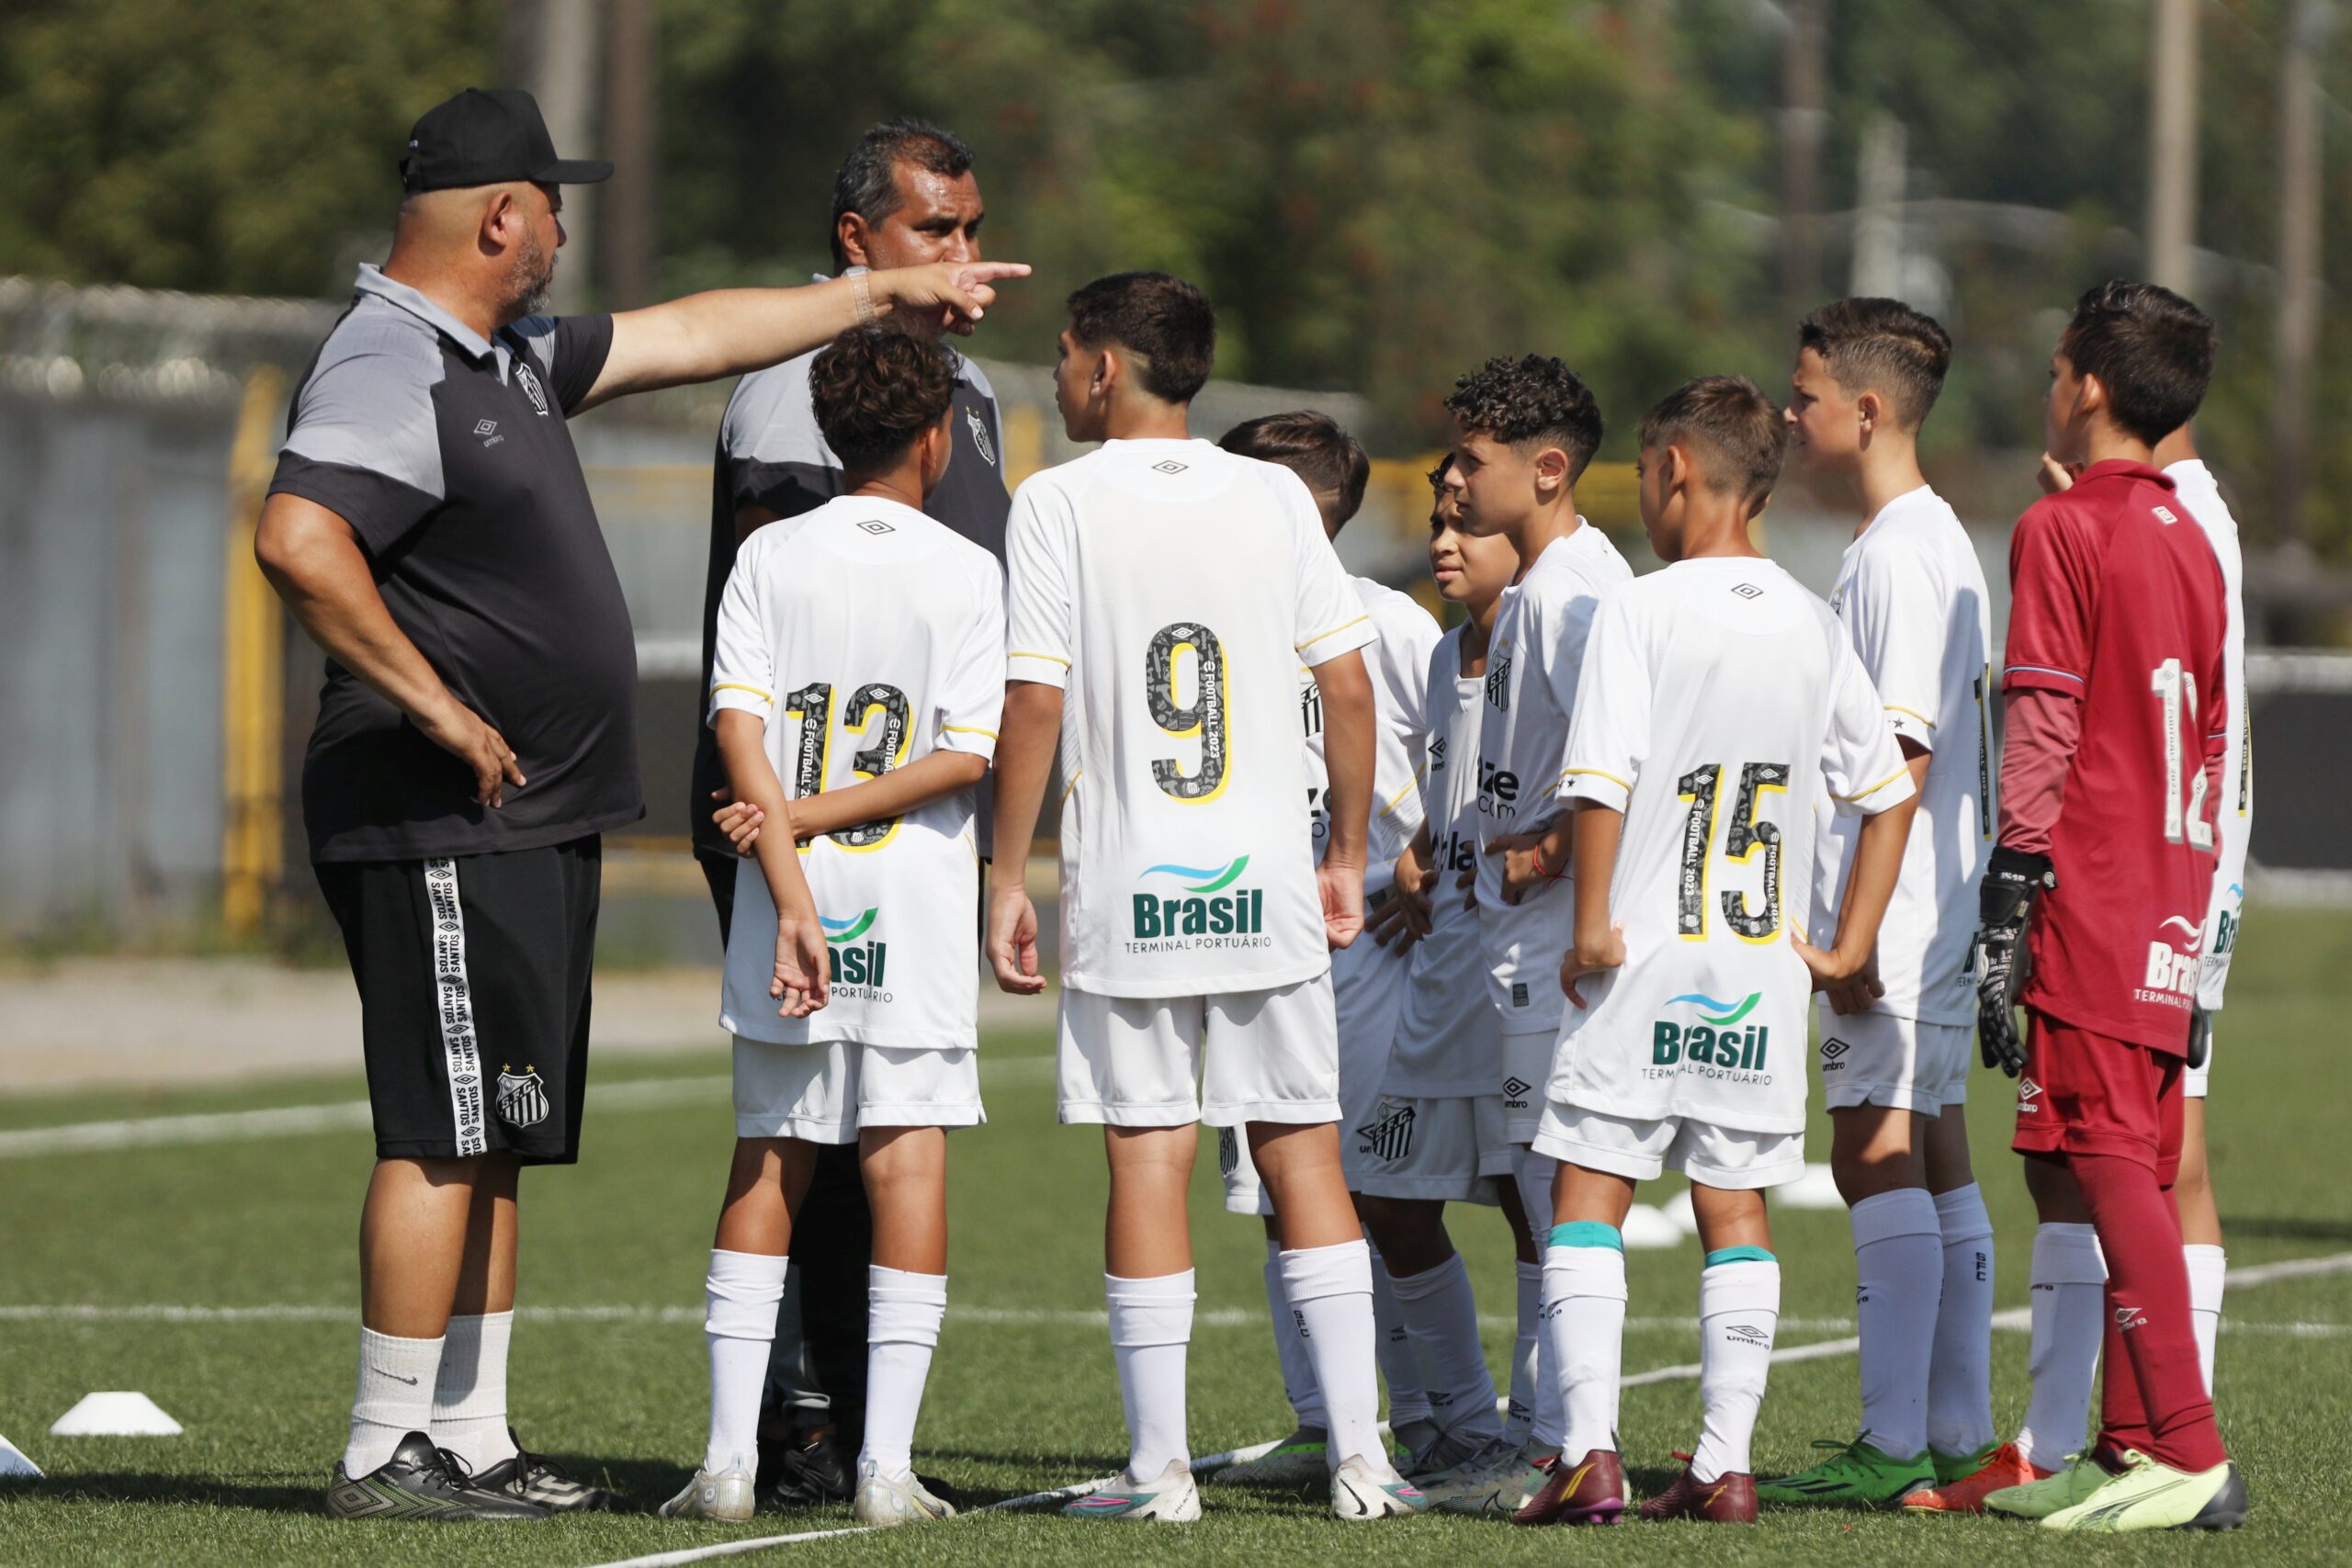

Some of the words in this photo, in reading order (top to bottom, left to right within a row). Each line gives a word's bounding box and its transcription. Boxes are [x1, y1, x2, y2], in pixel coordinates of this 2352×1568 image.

[1147, 622, 1228, 801] 9
[1208, 730, 1221, 759] 2023
[786, 682, 912, 850] 13
[1678, 762, 1790, 942] 15
[431, 882, 447, 919] SANTOS
[443, 882, 458, 920] SANTOS
[1684, 868, 1696, 897] 2023
[1133, 889, 1262, 939] Brasil
[438, 934, 449, 974] SANTOS
[450, 934, 460, 973] SANTOS
[1125, 939, 1191, 953] TERMINAL
[1195, 935, 1272, 949] PORTUÁRIO
[444, 986, 456, 1024] SANTOS
[455, 986, 468, 1022] SANTOS
[831, 987, 893, 1003] PORTUÁRIO
[2134, 988, 2182, 1008] TERMINAL
[449, 1036, 462, 1073] SANTOS
[461, 1035, 475, 1072] SANTOS
[1652, 1021, 1769, 1071] Brasil
[1698, 1066, 1772, 1087] PORTUÁRIO
[1823, 1060, 1845, 1072] umbro
[457, 1087, 469, 1126] SANTOS
[469, 1086, 480, 1123] SANTOS
[1976, 1252, 1986, 1281] SFC
[1294, 1310, 1310, 1337] SFC
[1726, 1335, 1770, 1350] umbro
